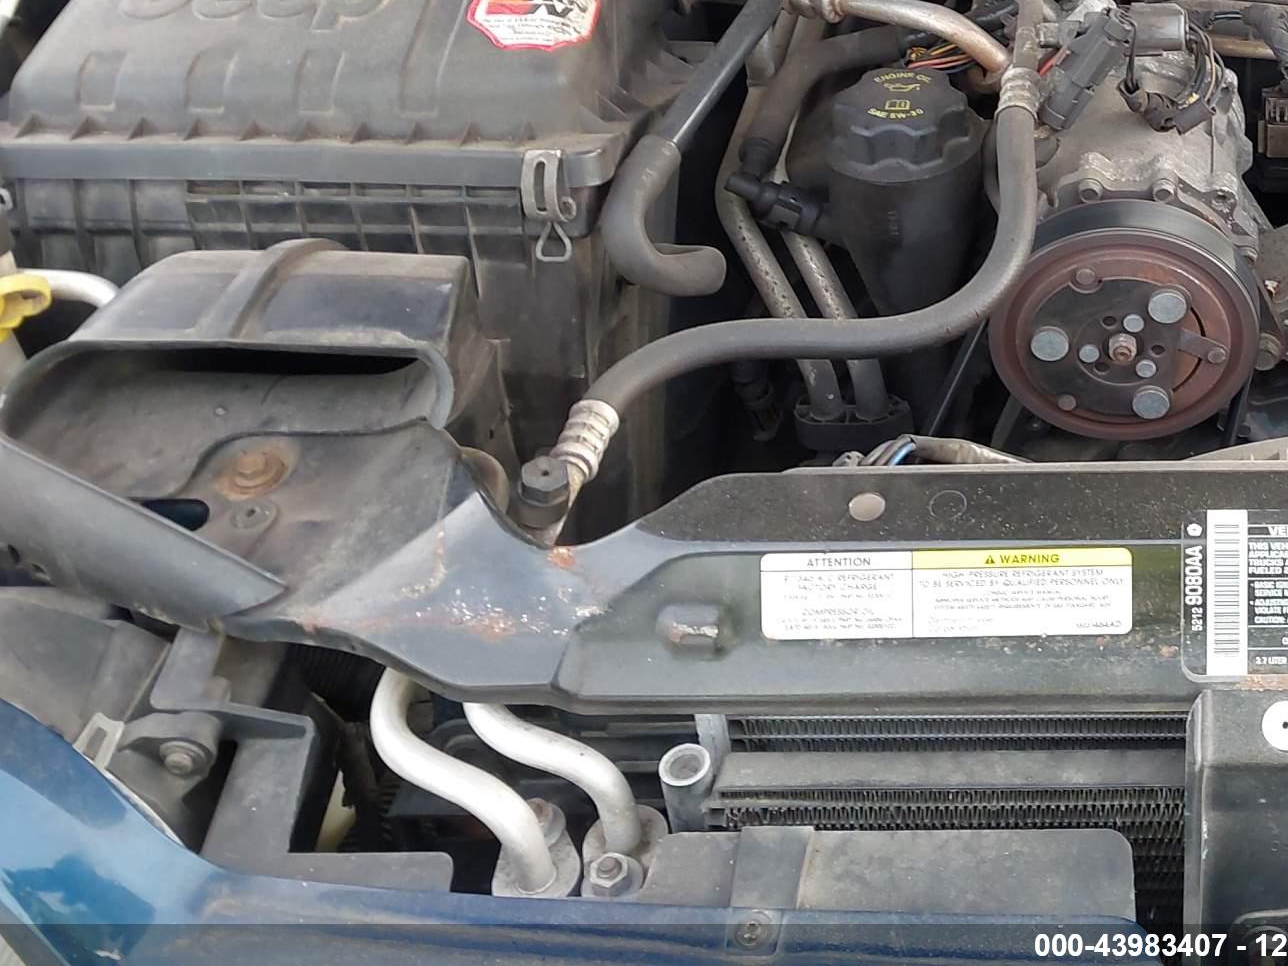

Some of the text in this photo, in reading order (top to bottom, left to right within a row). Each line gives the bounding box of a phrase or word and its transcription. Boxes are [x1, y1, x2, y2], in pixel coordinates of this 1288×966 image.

[873, 72, 932, 84] ENGINE OIL
[807, 557, 872, 567] ATTENTION
[1000, 553, 1060, 564] WARNING
[1186, 545, 1203, 631] 5212 9080AA
